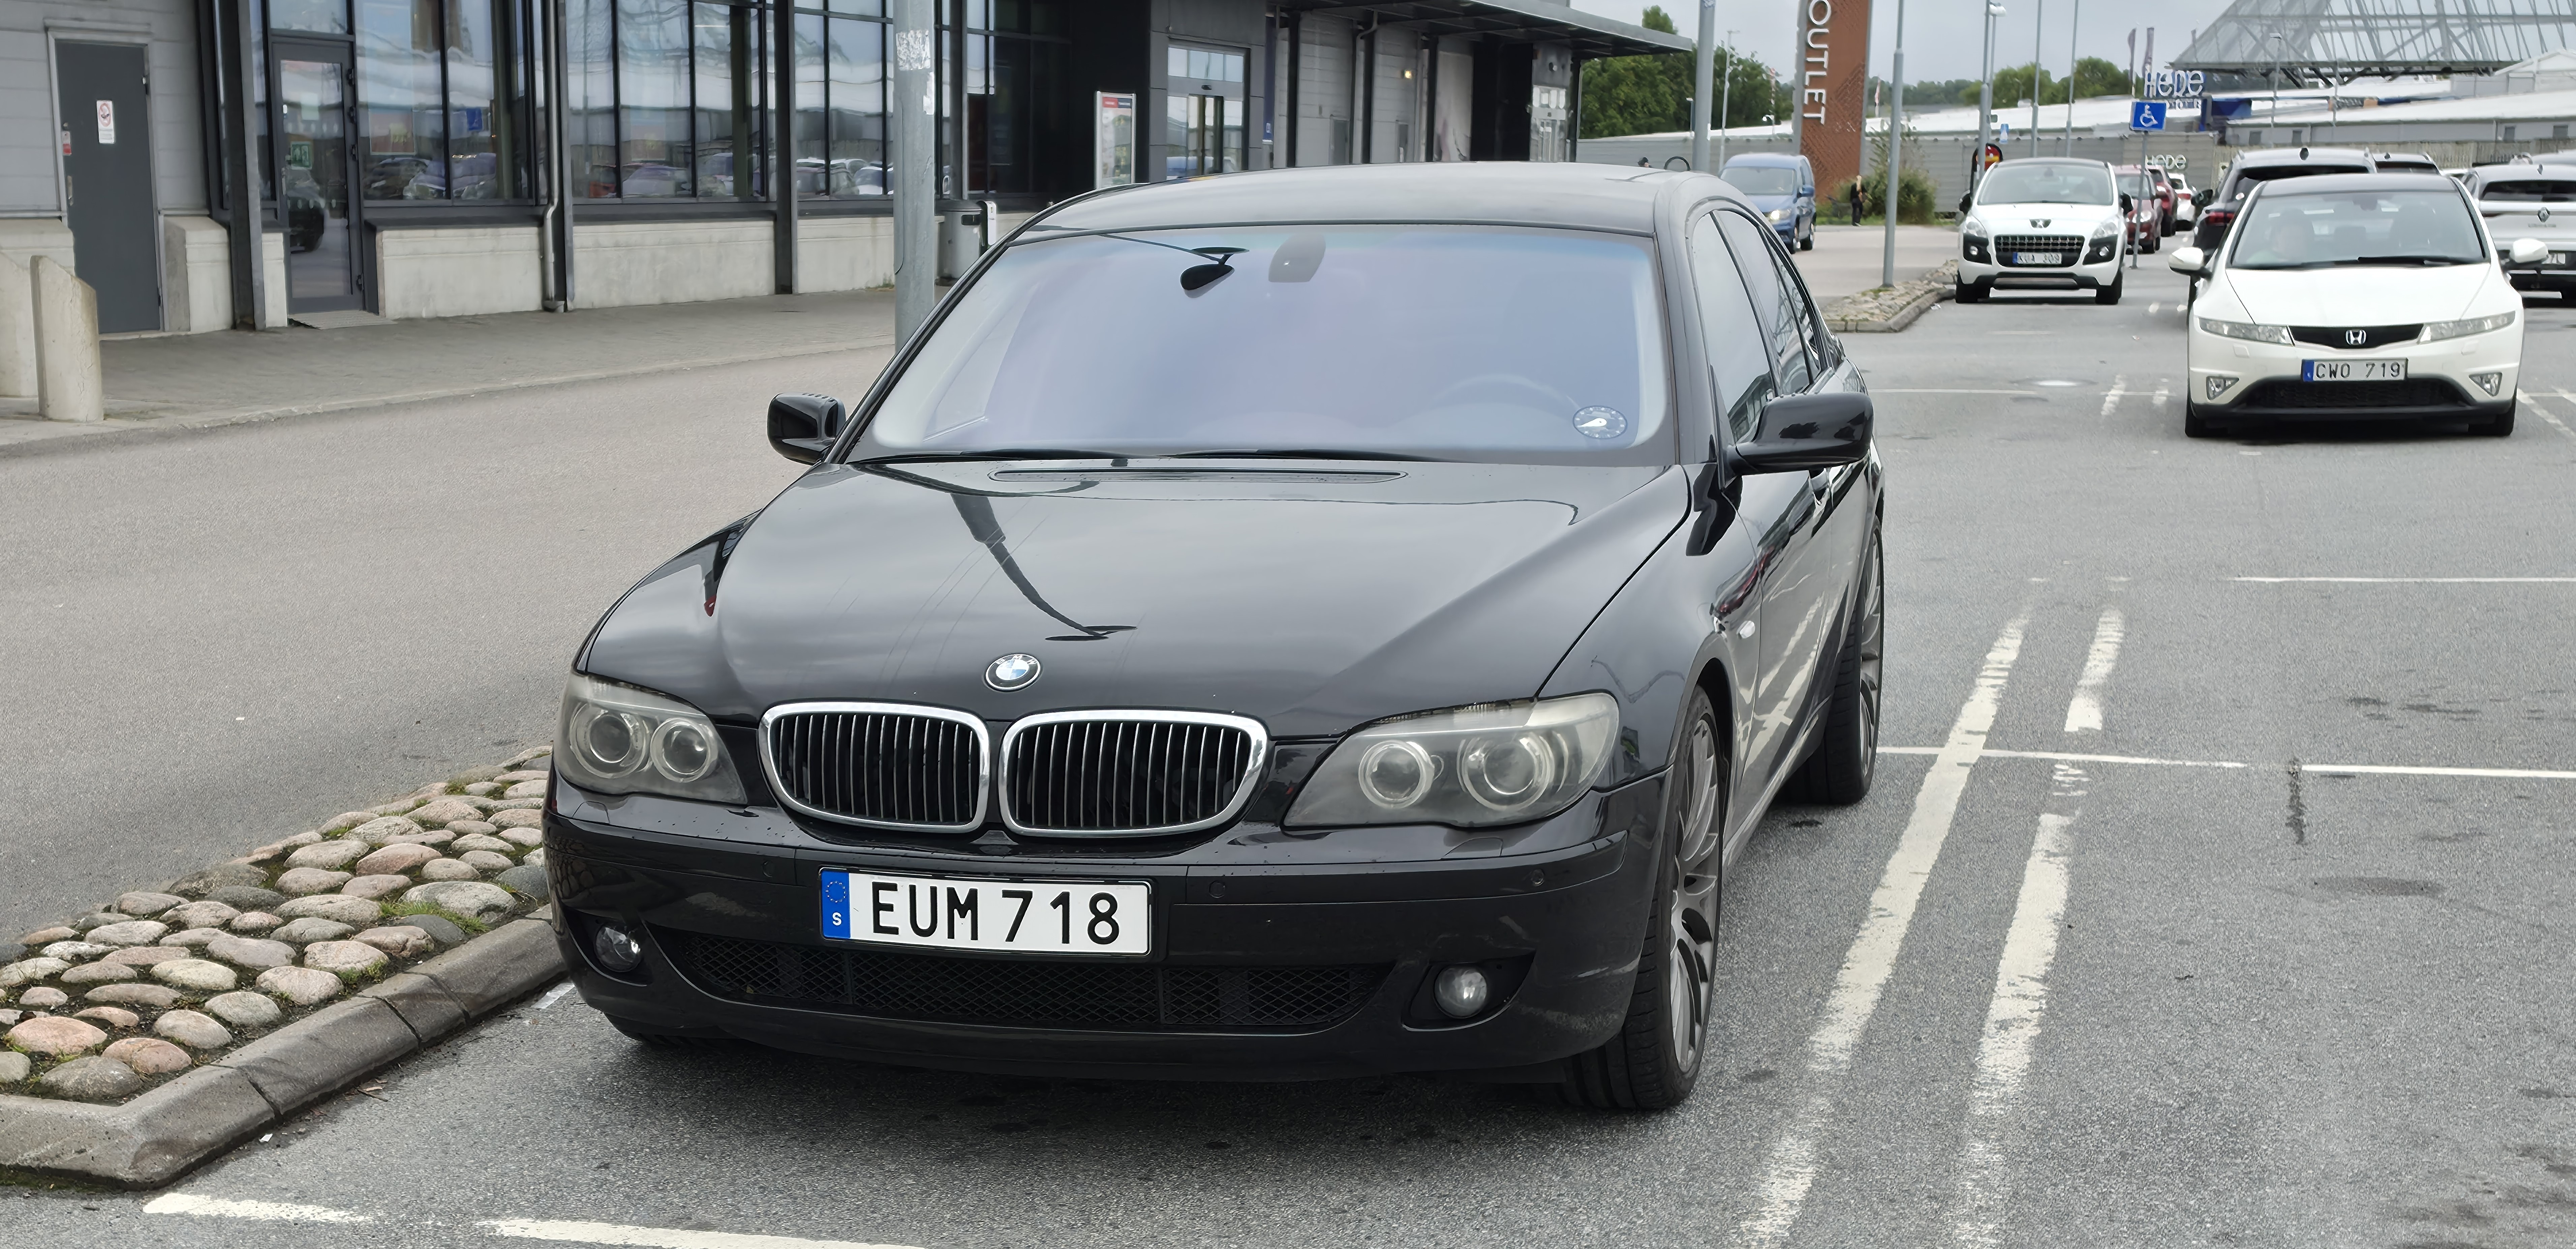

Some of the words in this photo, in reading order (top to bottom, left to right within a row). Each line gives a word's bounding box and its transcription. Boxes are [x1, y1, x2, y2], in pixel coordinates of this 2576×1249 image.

[1803, 0, 1831, 125] OUTLET
[2316, 363, 2351, 379] CWO
[2365, 362, 2400, 378] 719
[832, 912, 842, 926] S
[872, 881, 978, 941] EUM
[1002, 889, 1120, 945] 718
